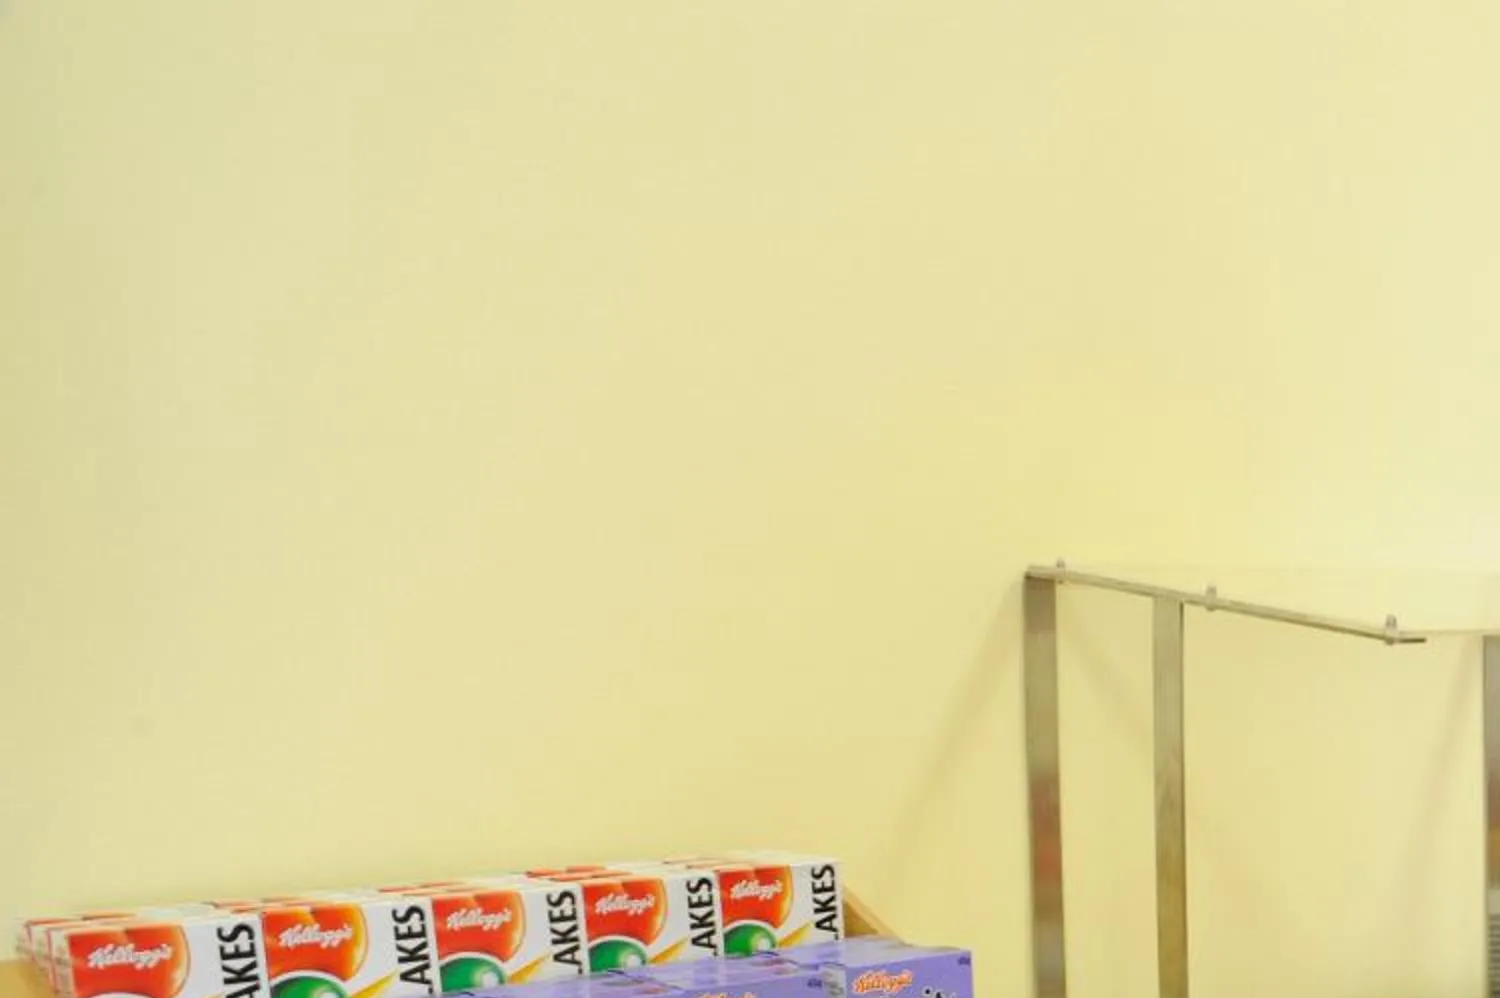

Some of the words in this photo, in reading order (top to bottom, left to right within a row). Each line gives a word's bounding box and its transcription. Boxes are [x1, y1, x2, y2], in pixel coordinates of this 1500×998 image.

[595, 892, 656, 915] Kellogg's
[730, 879, 784, 901] Kellogg's
[811, 863, 840, 940] AKES
[447, 908, 513, 931] Kellogg's
[686, 877, 719, 957] AKES
[279, 923, 353, 948] Kellogg's
[546, 889, 583, 975] AKES
[88, 943, 173, 970] Kellogg's
[392, 905, 434, 995] AKES
